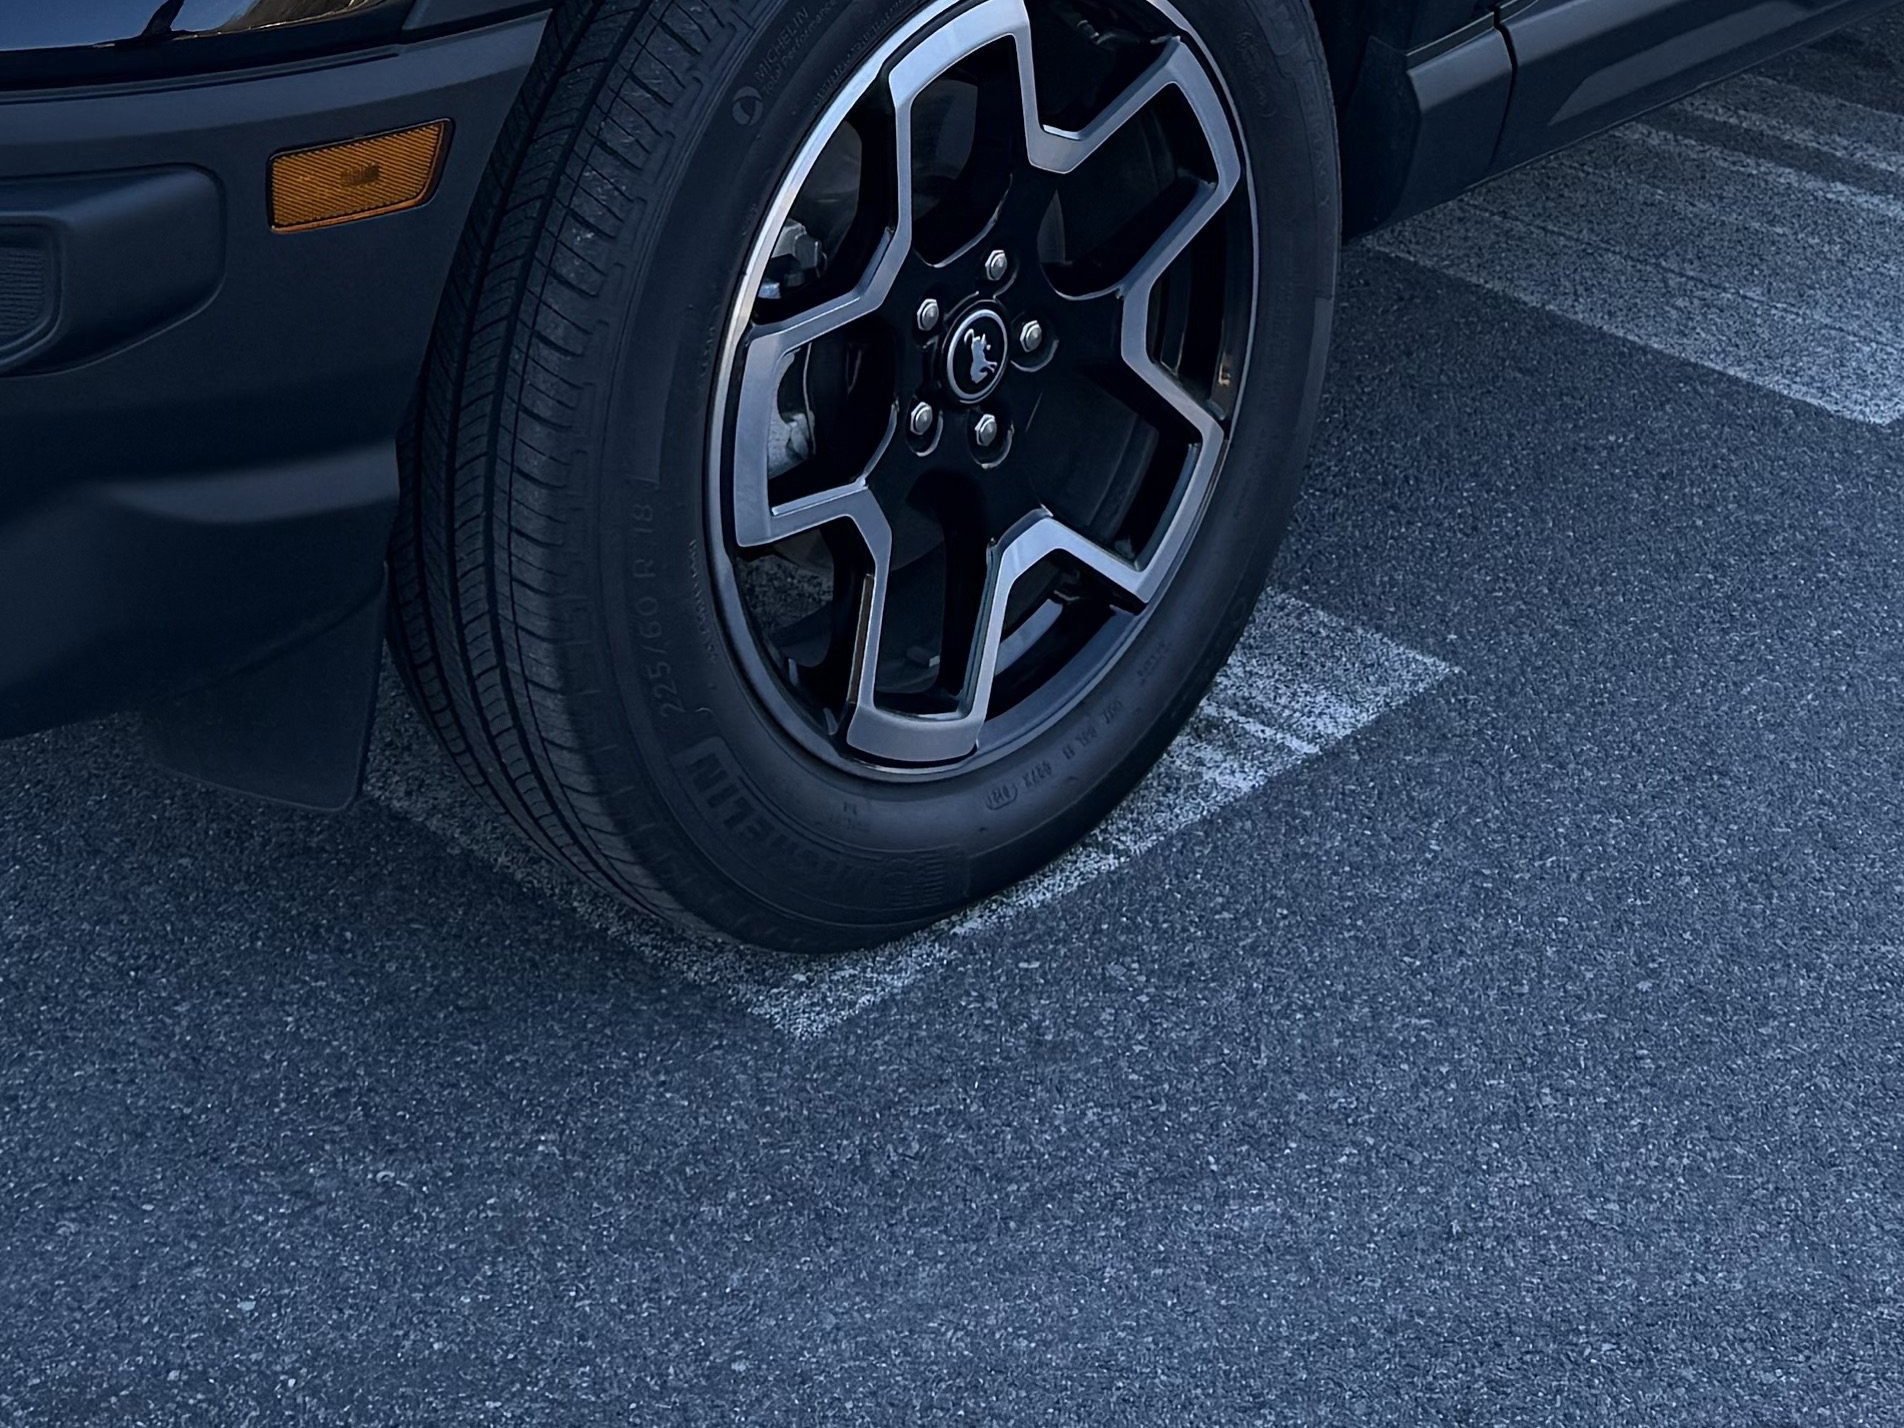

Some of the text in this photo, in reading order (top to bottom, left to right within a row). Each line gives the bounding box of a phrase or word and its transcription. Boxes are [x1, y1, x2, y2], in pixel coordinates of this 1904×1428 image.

[753, 6, 809, 82] MICHELIN
[632, 503, 653, 533] 18
[637, 597, 686, 718] 225/60
